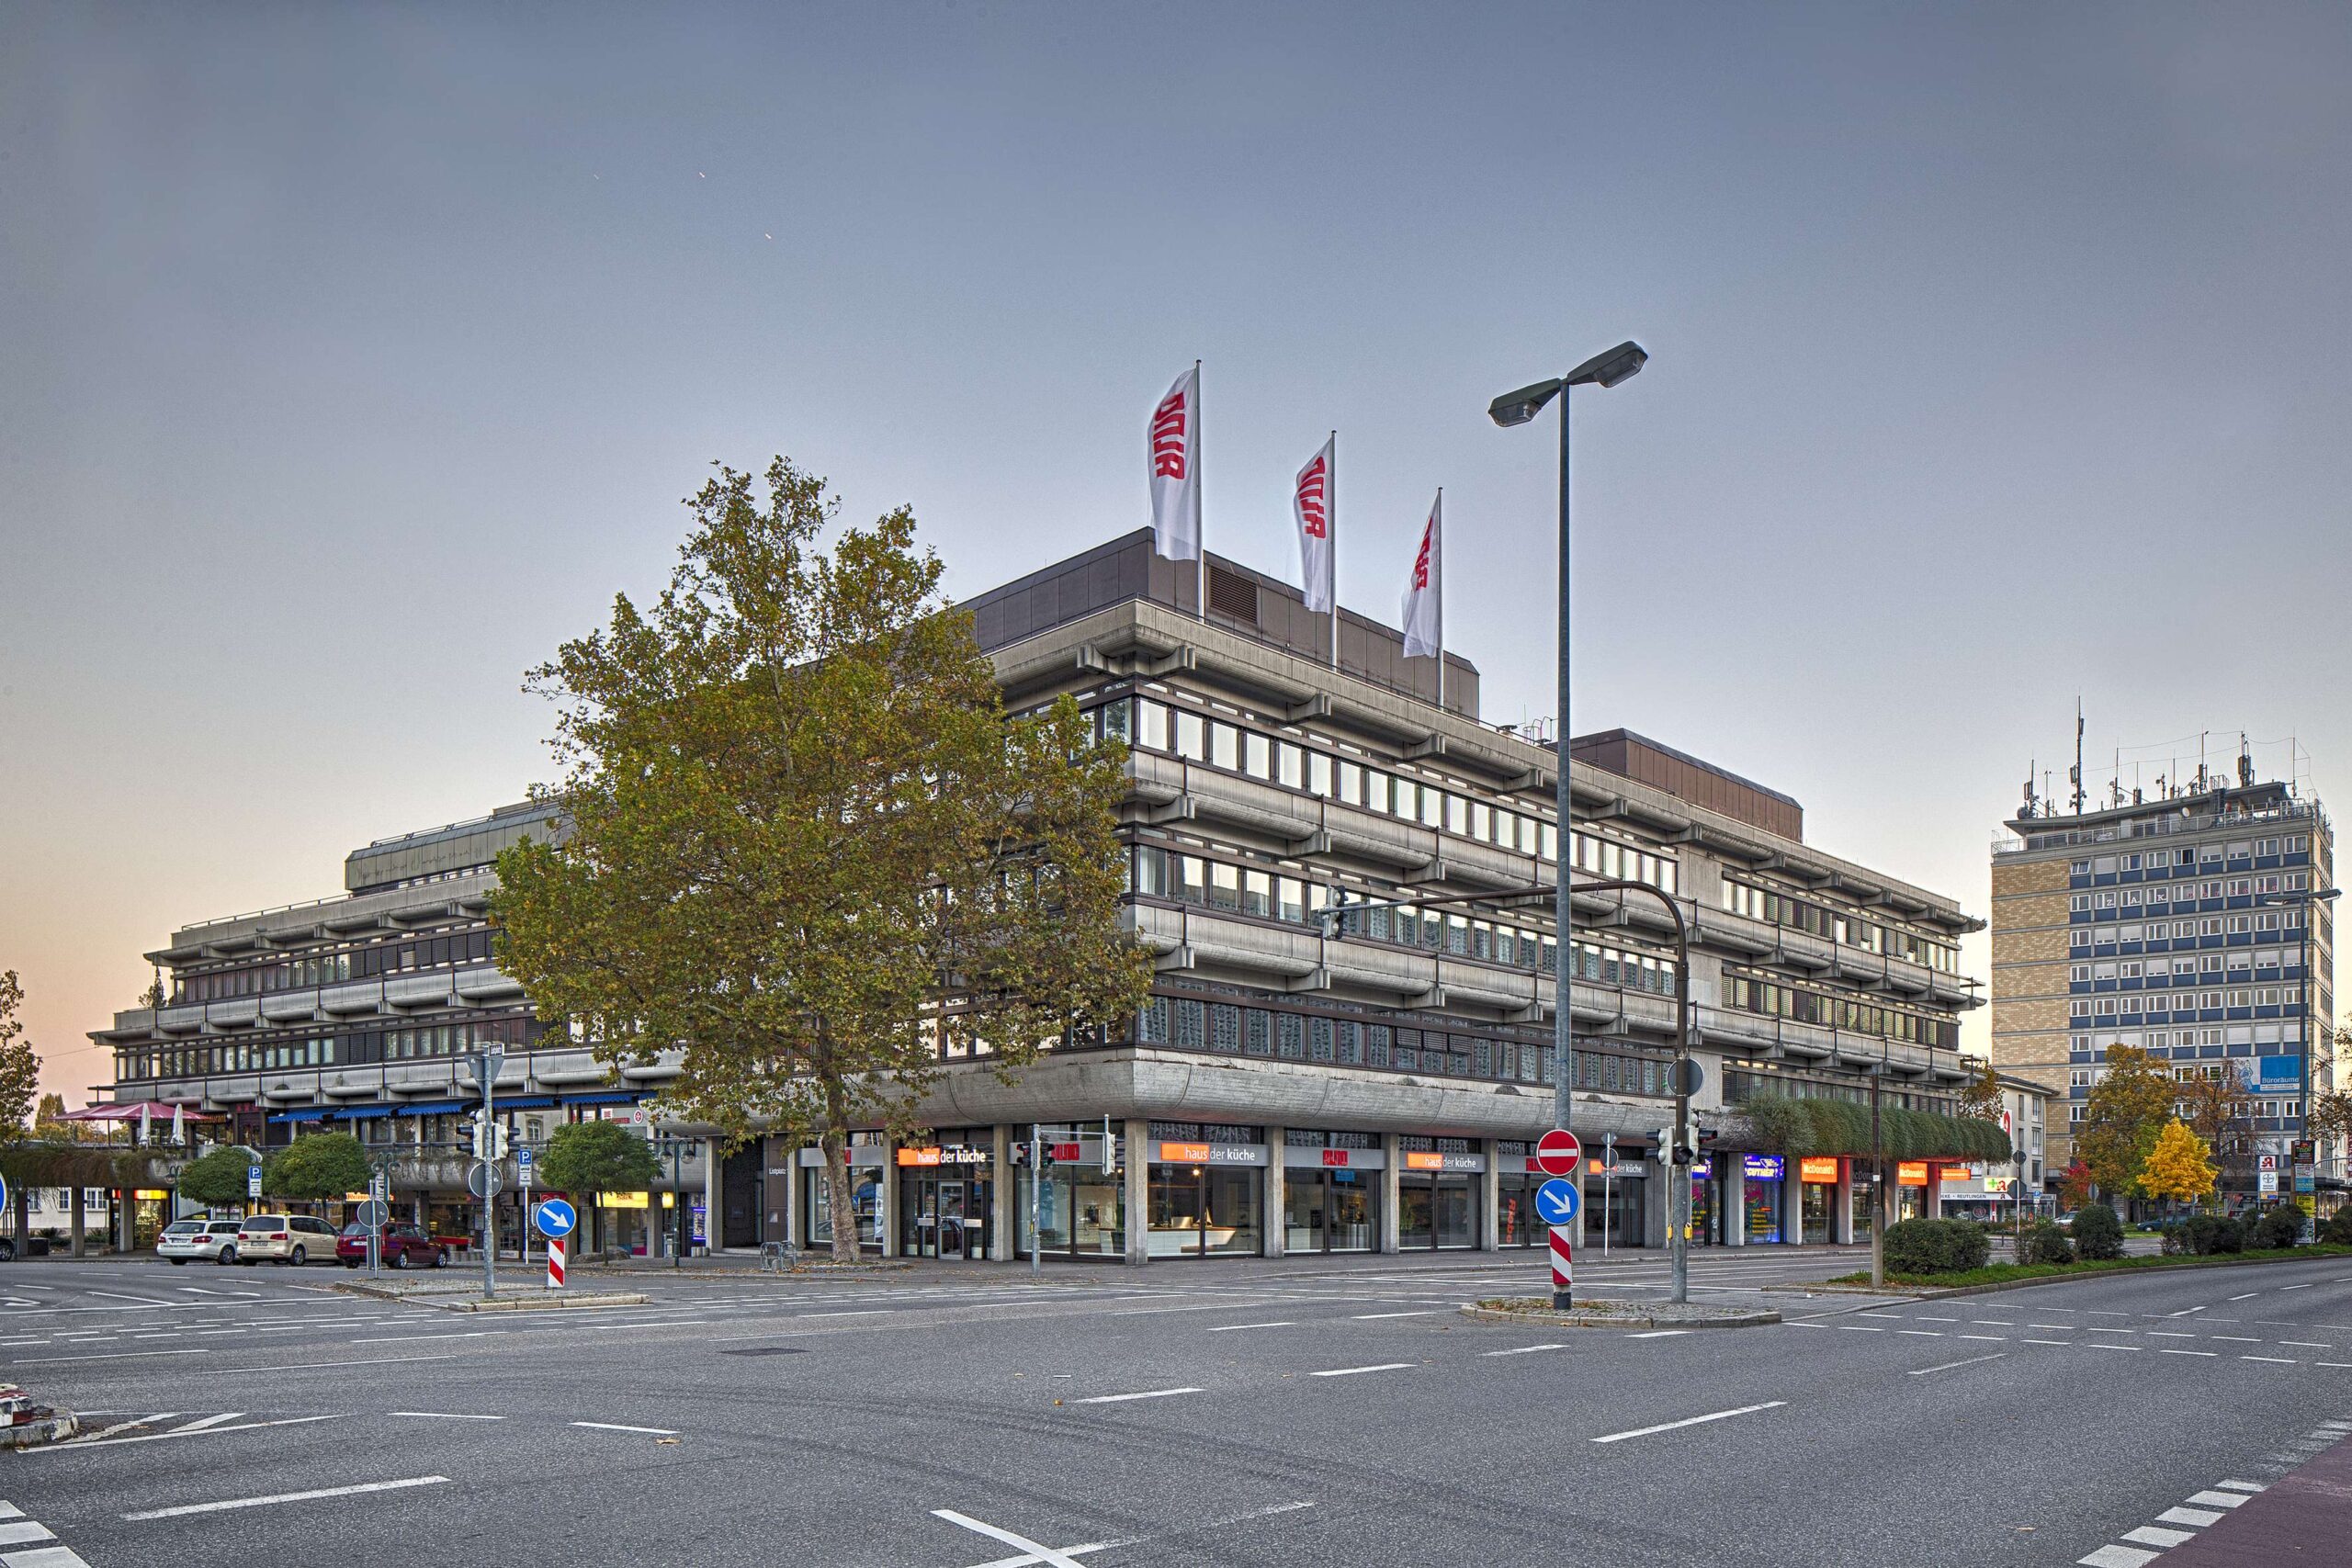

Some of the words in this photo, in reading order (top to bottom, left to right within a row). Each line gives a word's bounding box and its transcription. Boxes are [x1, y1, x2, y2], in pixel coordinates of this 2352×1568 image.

[917, 1150, 938, 1163] haus
[940, 1150, 956, 1163] der
[956, 1149, 986, 1163] küche
[1184, 1146, 1208, 1159] haus
[1209, 1147, 1225, 1160] der
[1227, 1148, 1255, 1161] küche
[1425, 1156, 1442, 1167] haus
[1442, 1157, 1454, 1168] der
[1454, 1157, 1476, 1168] küche
[1617, 1164, 1625, 1173] der
[1625, 1164, 1643, 1173] küche
[1804, 1164, 1835, 1175] McDonald's
